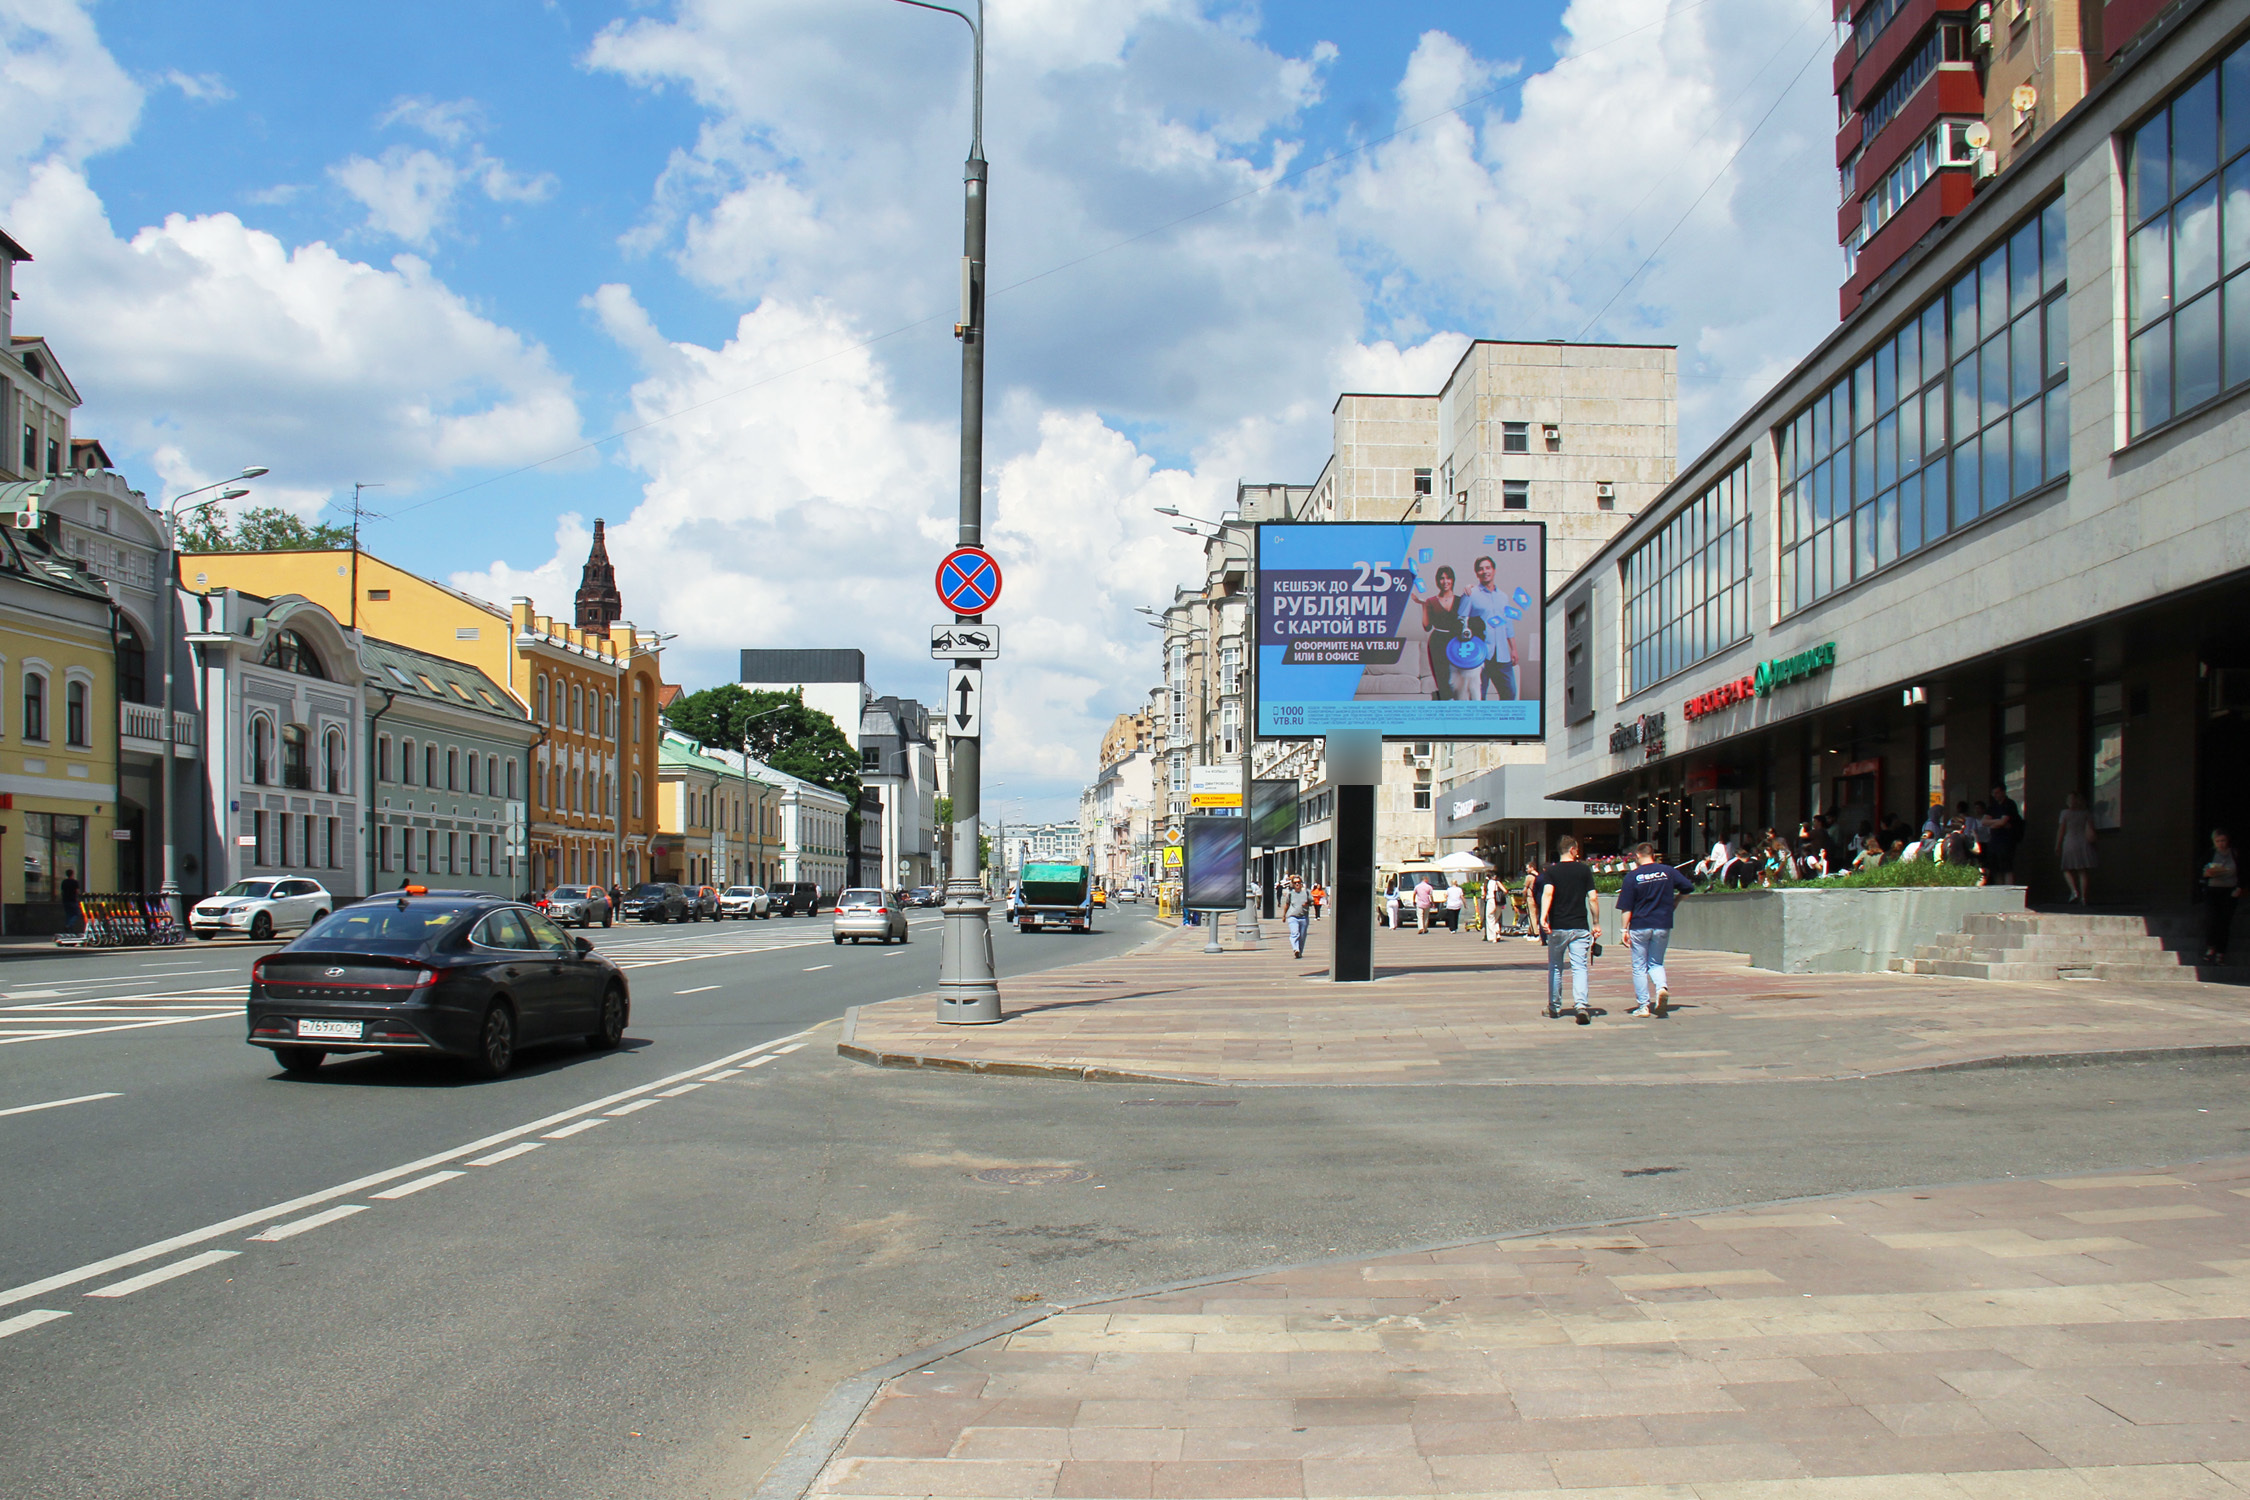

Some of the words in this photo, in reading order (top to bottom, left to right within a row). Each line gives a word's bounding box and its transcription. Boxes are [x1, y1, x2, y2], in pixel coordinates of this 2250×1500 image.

[1274, 535, 1285, 544] 0+
[1497, 537, 1527, 552] ВТБ
[1273, 580, 1327, 592] КЕШБЭК
[1329, 580, 1349, 595] ДО
[1351, 560, 1408, 592] 25%
[1273, 596, 1388, 616] РУБЛЯМИ
[1273, 621, 1285, 634] С
[1288, 618, 1355, 634] КАРТОЙ
[1357, 621, 1387, 634] ВТБ
[1294, 641, 1349, 651] ОФОРМИТЕ
[1350, 642, 1364, 650] НА
[1365, 642, 1400, 650] VTB.RU
[1294, 652, 1315, 661] ИЛИ
[1316, 652, 1323, 661] В
[1324, 652, 1360, 661] ОФИСЕ
[1280, 706, 1304, 716] 1000
[1273, 716, 1304, 726] VTB.RU
